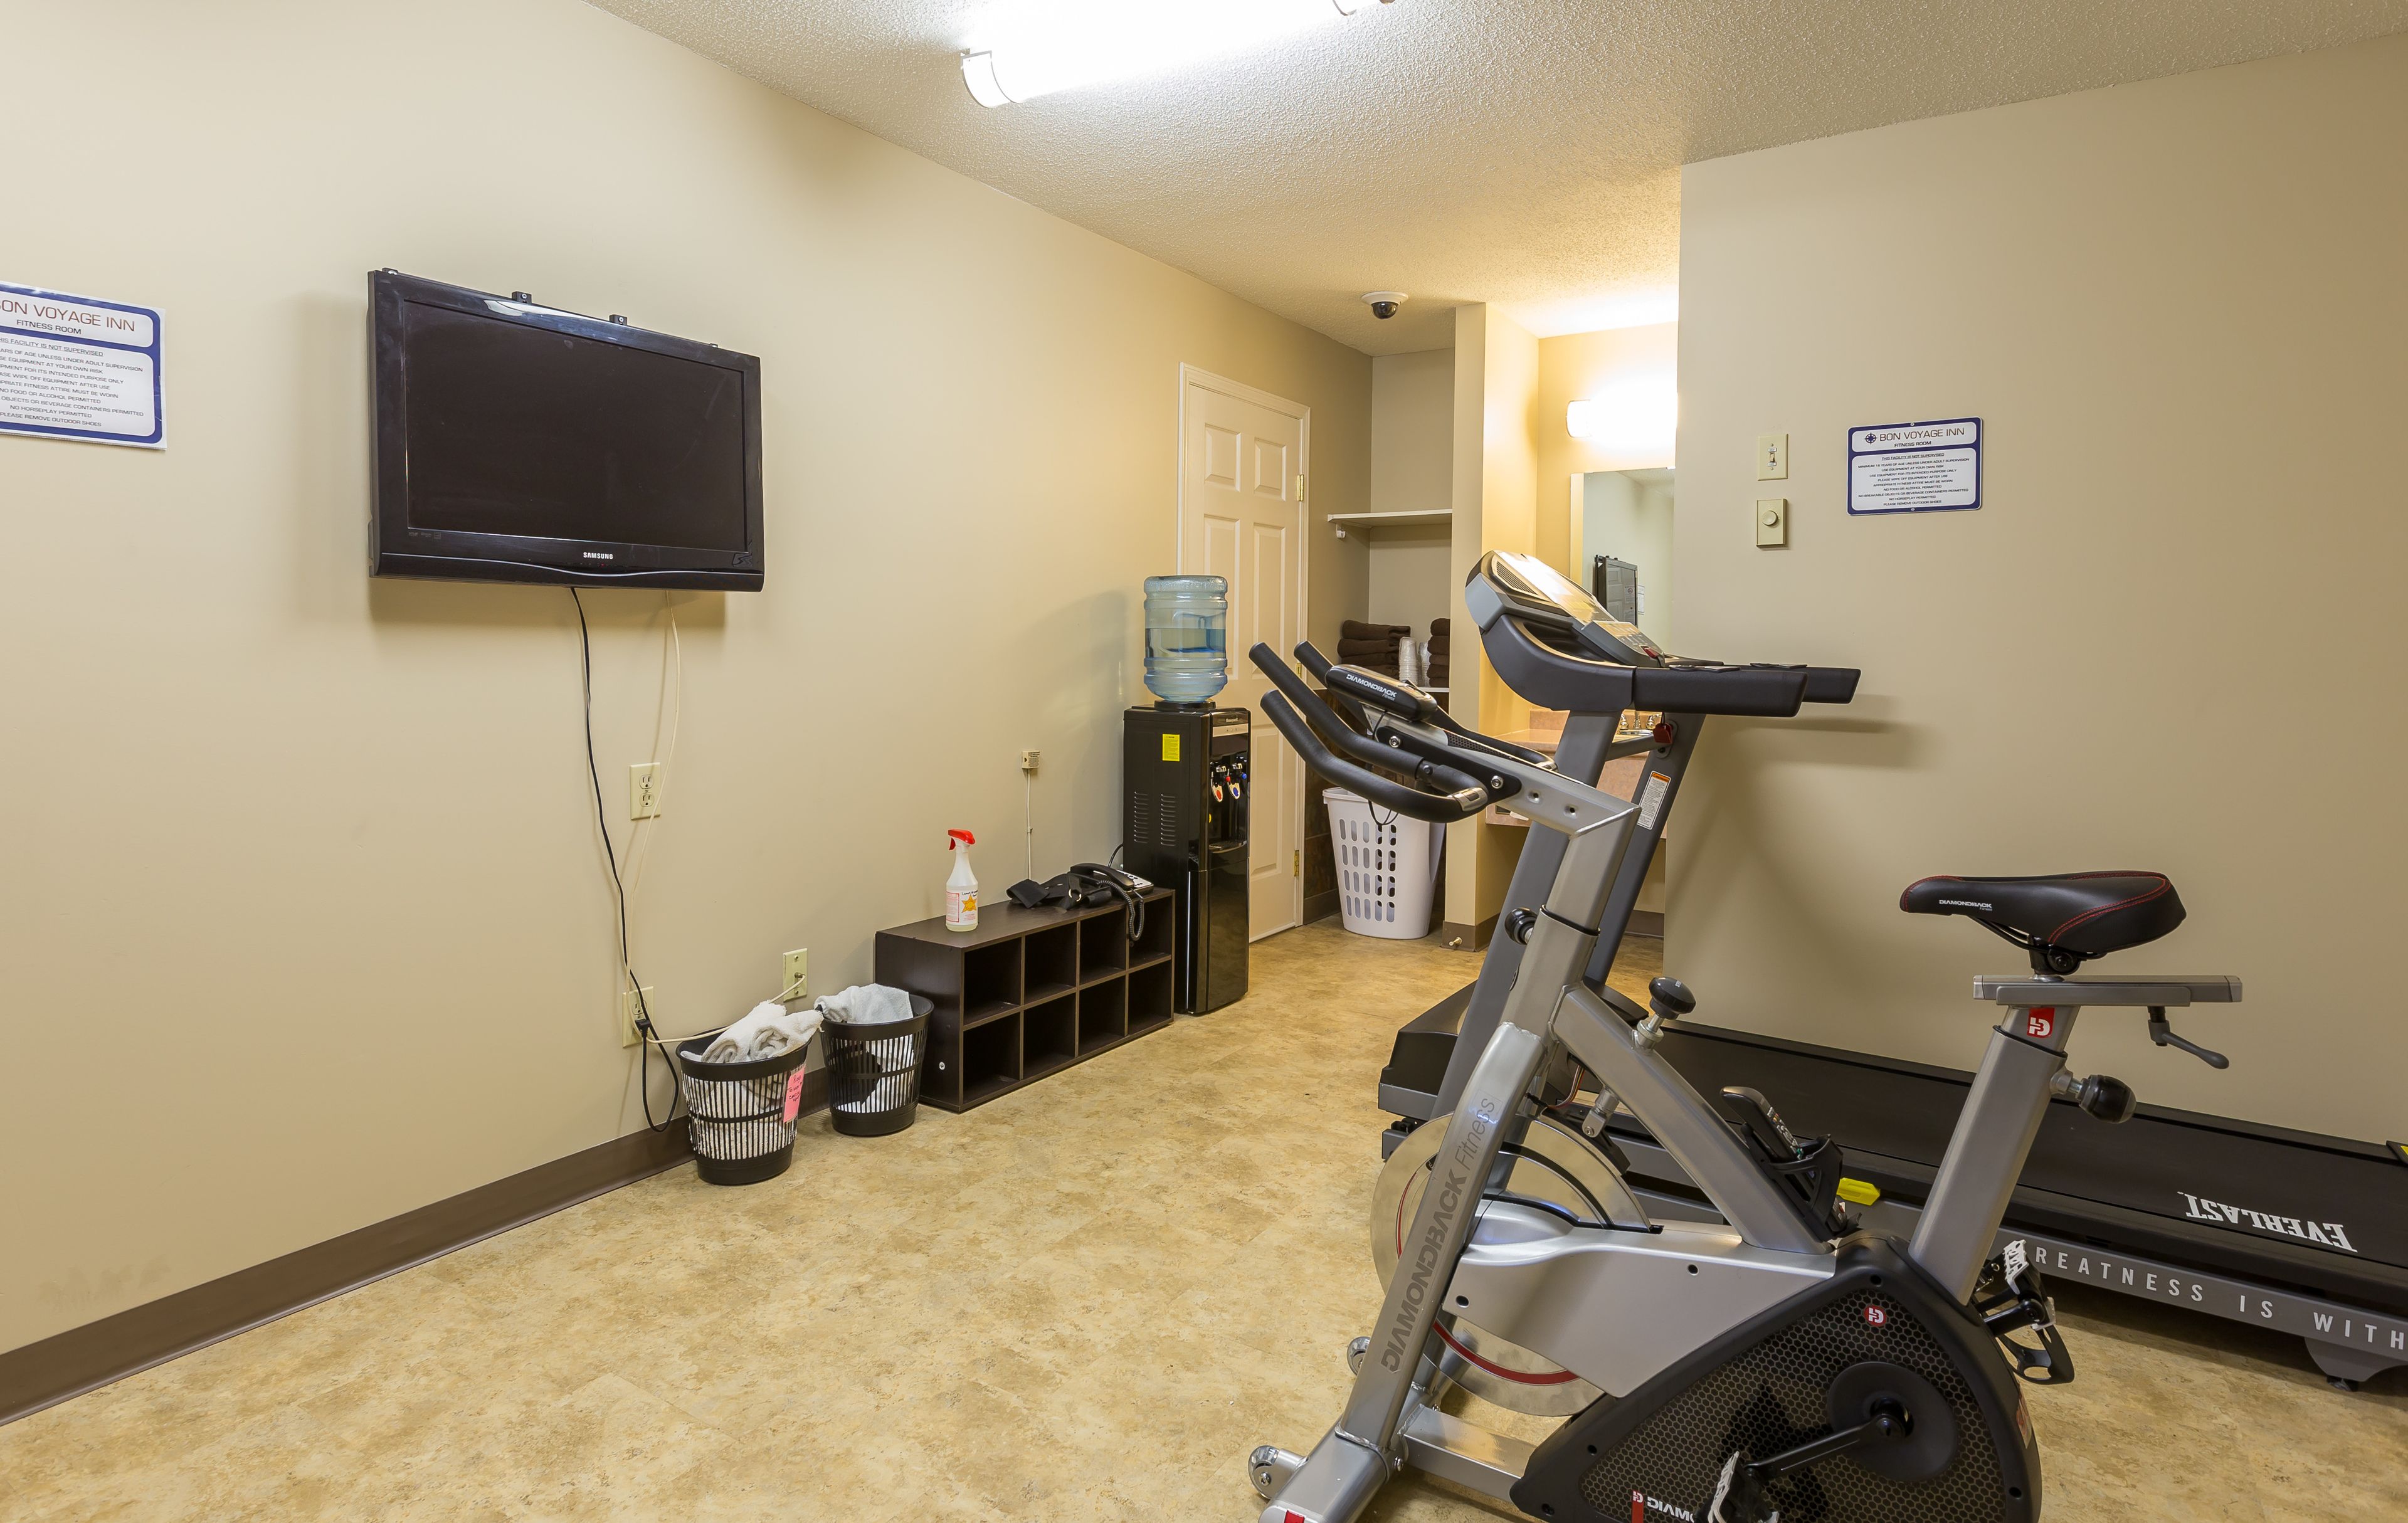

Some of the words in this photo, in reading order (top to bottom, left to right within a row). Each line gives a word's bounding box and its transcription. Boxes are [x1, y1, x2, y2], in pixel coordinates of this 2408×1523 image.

[0, 299, 27, 315] ON
[33, 305, 101, 326] VOYAGE
[106, 316, 134, 331] INN
[16, 319, 52, 330] FITNESS
[55, 325, 81, 334] ROOM
[10, 339, 39, 347] FACILITY
[63, 346, 103, 356] SUPERVISED
[8, 357, 44, 366] EQUIPMENT
[105, 363, 143, 371] SUPERVISION
[42, 377, 77, 385] EQUIPMENT
[21, 406, 57, 414] HORSEPLAY
[73, 404, 110, 412] CONTAINERS
[1879, 432, 1900, 441] BON
[1903, 429, 1943, 439] VOYAGE
[1946, 427, 1964, 436] INN
[1346, 673, 1397, 697] DIAMONDBACK
[1939, 900, 1992, 908] DIAMONDBACK
[2184, 1193, 2358, 1253] EVERLAST
[1381, 1168, 1470, 1373] DIAMONDBACK
[1454, 1098, 1495, 1171] Fitness
[2036, 1246, 2203, 1302] REATNESS
[2239, 1295, 2273, 1318] IS
